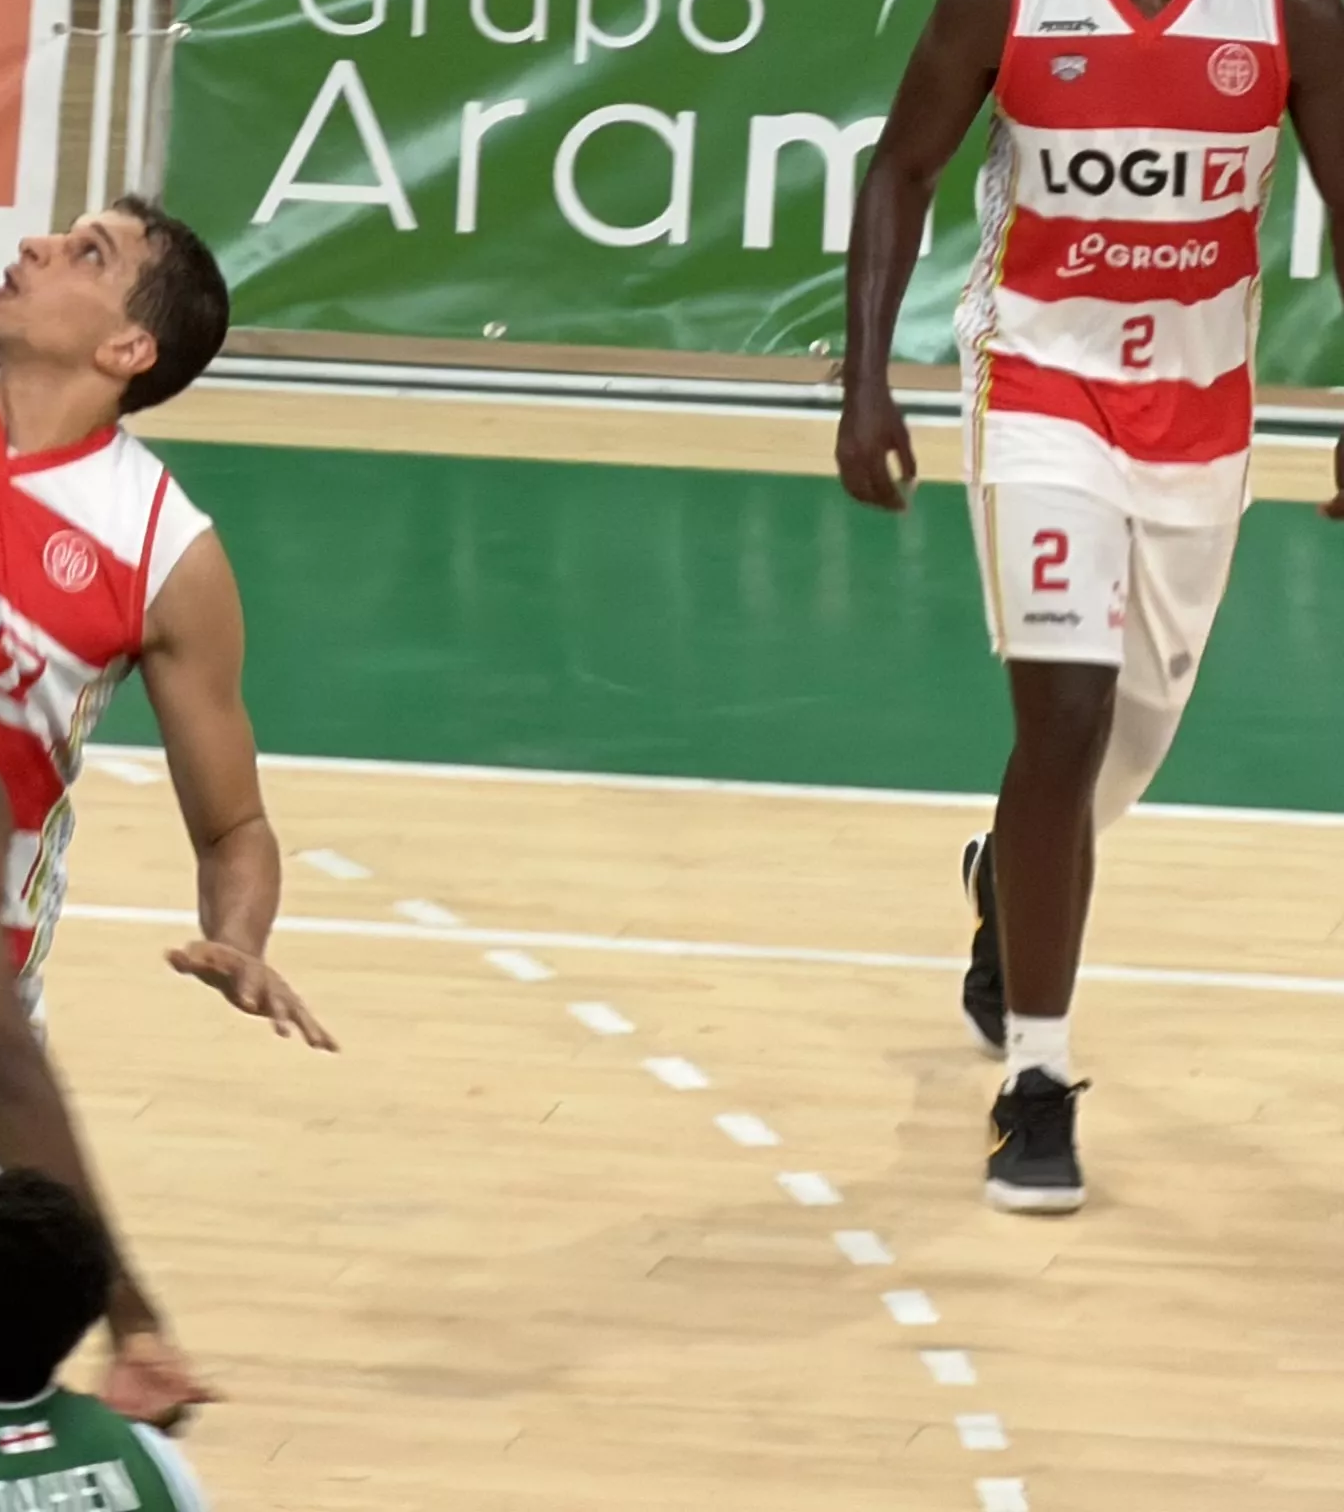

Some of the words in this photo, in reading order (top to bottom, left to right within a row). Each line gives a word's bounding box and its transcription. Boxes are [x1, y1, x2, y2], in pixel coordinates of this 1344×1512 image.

[1058, 232, 1219, 276] LOGROÑO
[1120, 314, 1155, 370] 2
[1032, 528, 1070, 594] 2
